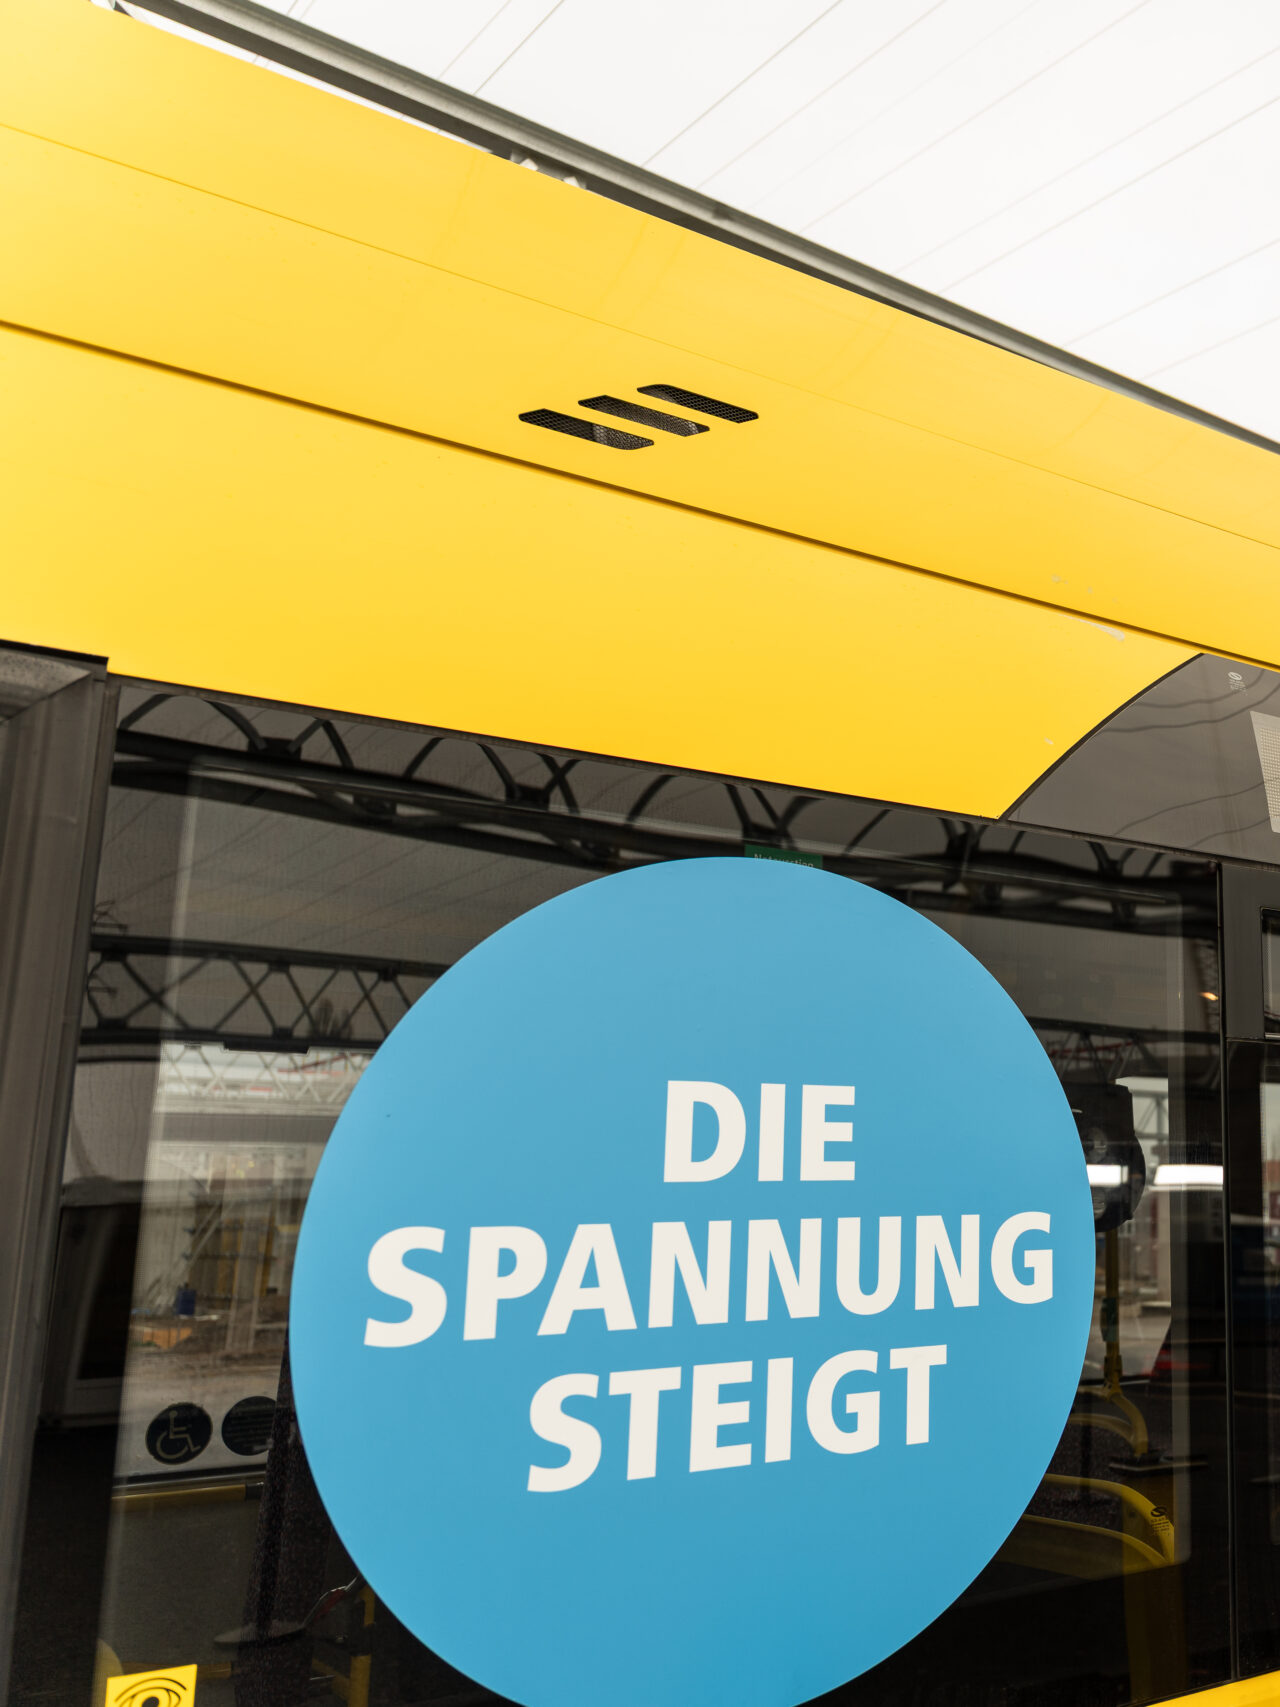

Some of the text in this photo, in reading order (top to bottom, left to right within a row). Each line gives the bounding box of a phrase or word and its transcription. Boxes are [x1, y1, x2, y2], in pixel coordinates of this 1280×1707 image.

[664, 1080, 856, 1183] DIE
[364, 1211, 1054, 1348] SPANNUNG
[527, 1344, 948, 1493] STEIGT
